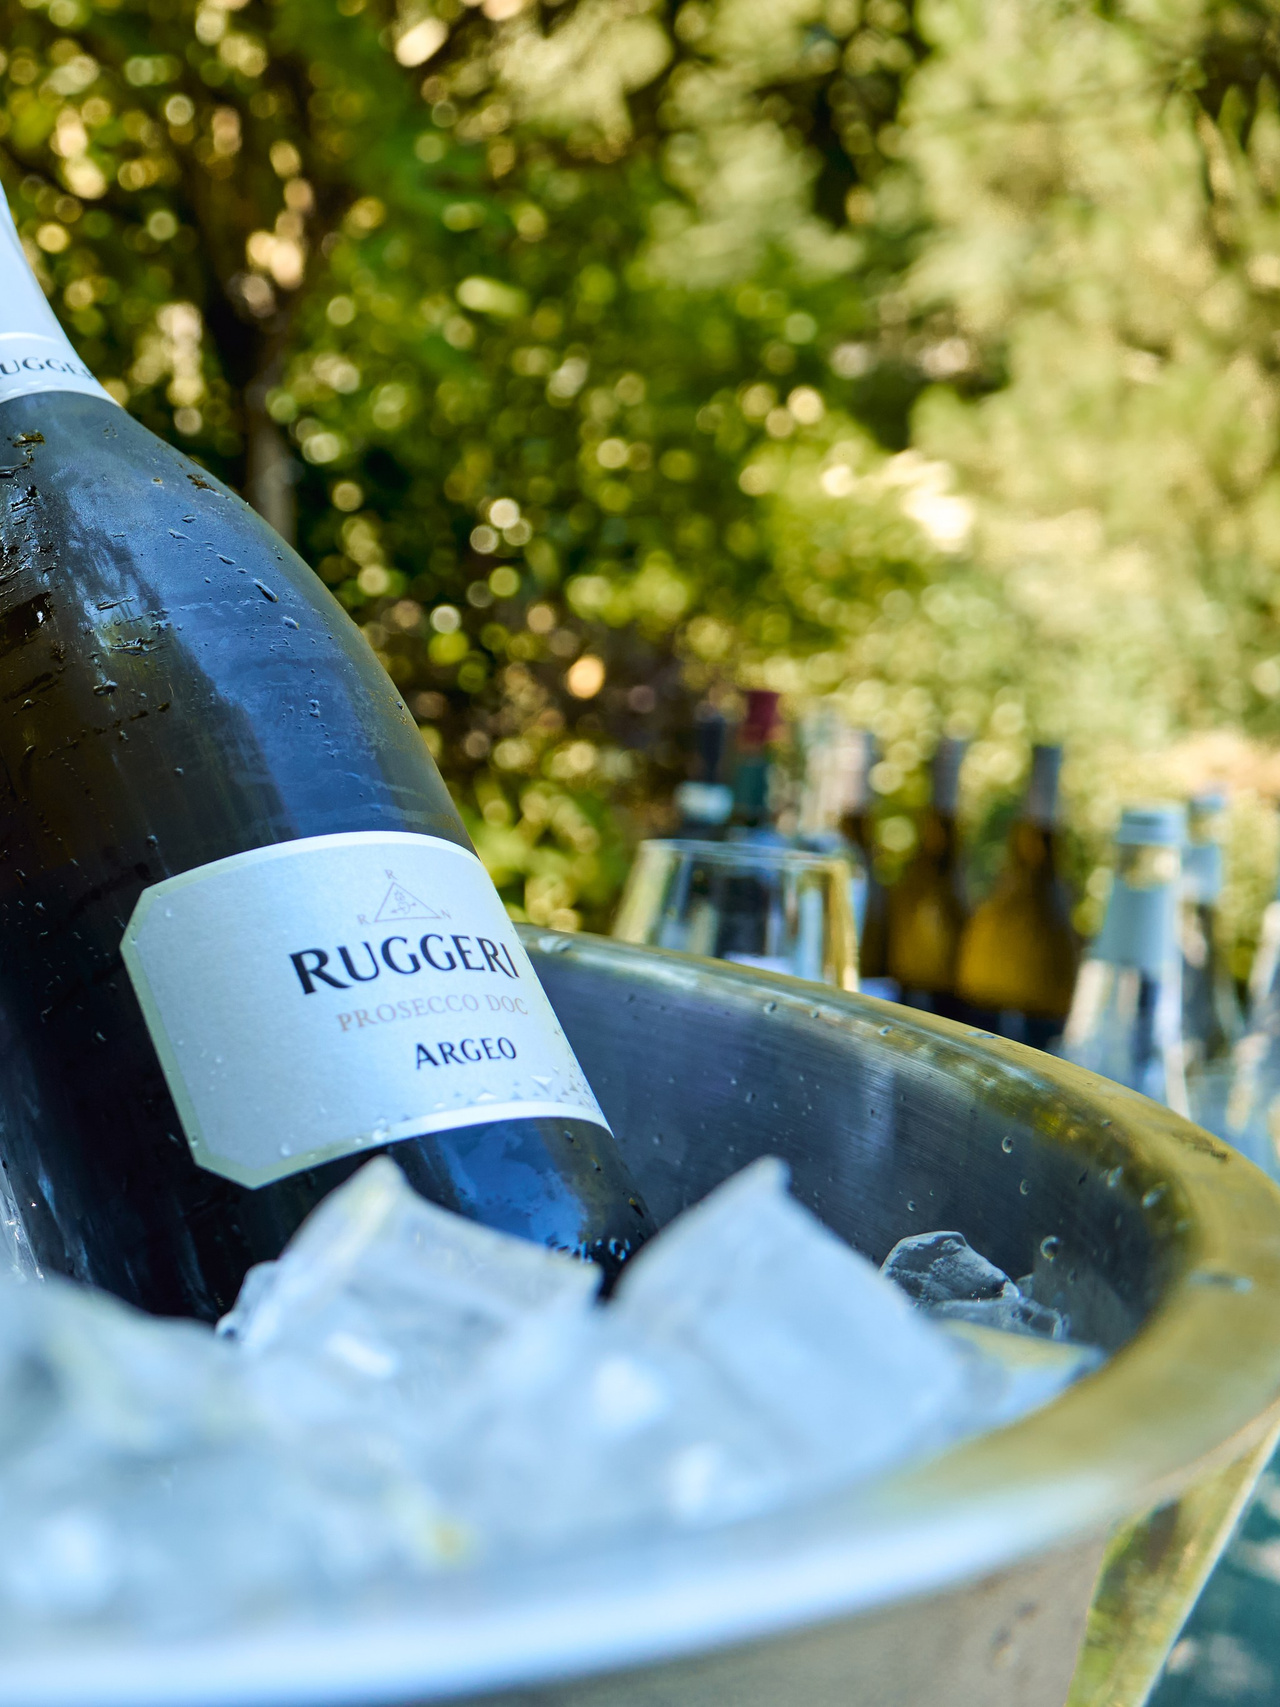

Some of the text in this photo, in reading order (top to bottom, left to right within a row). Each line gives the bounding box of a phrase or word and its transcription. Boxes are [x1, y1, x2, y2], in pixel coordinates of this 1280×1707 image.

[288, 933, 521, 995] RUGGERI
[336, 994, 529, 1032] PROSECCO DOC
[415, 1036, 518, 1070] ARGEO
